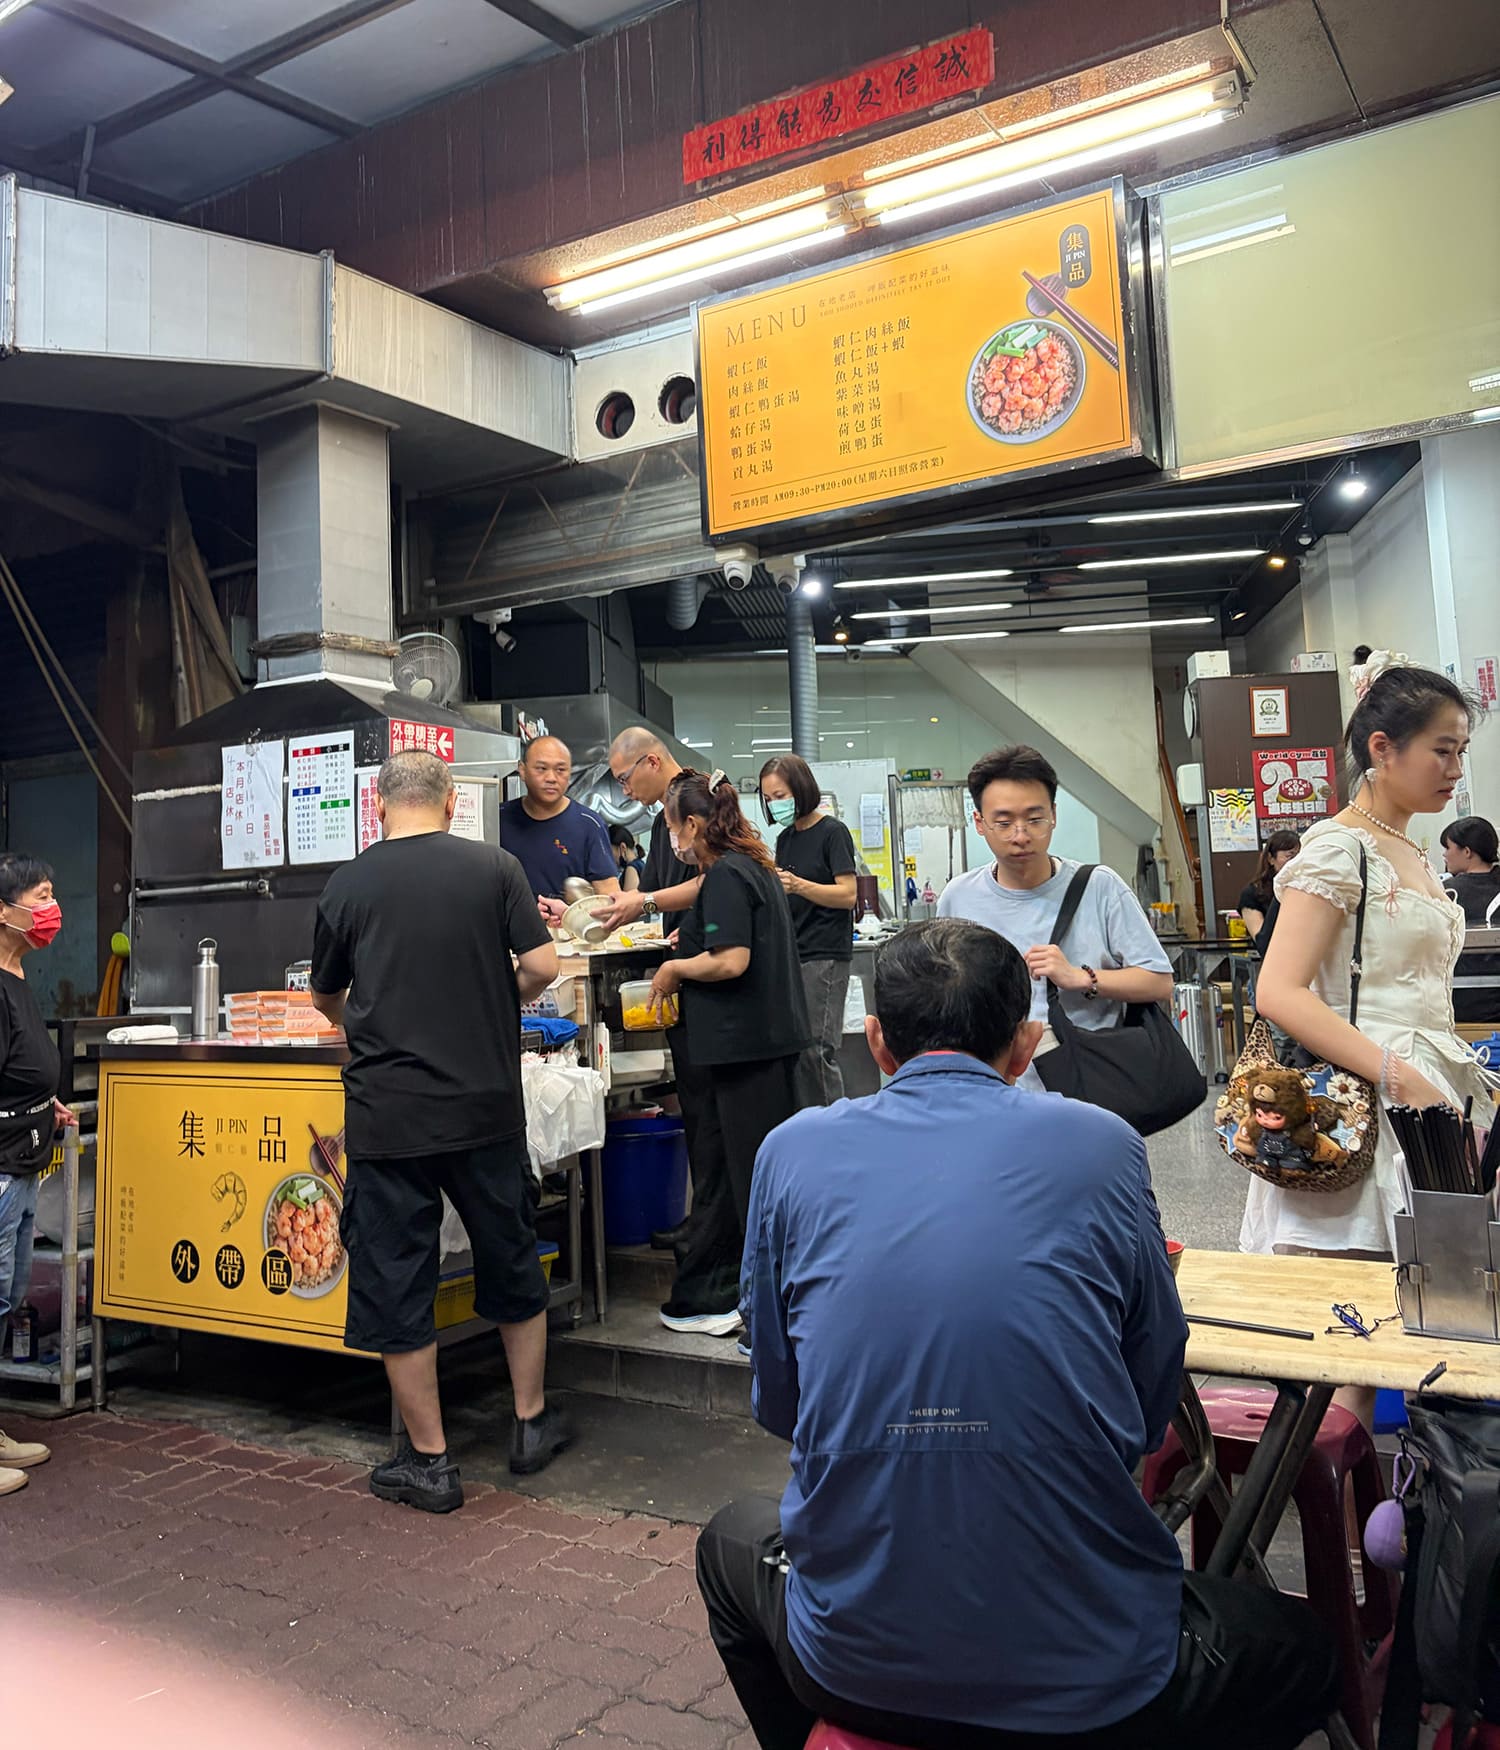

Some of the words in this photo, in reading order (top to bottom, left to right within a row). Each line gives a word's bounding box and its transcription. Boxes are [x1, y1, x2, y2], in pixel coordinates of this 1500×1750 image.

[1066, 231, 1084, 252] 集
[1069, 262, 1085, 282] 品
[726, 305, 807, 347] MENU
[833, 316, 911, 349] 蝦仁肉絲飯
[834, 336, 905, 367] 蝦仁飯+蝦
[727, 356, 768, 379] 蝦仁飯
[835, 361, 880, 385] 魚丸湯
[728, 377, 769, 399] 肉絲飯
[836, 379, 880, 402] 紫菜湯
[729, 390, 800, 419] 蝦仁鴨蛋湯
[836, 397, 881, 418] 味噌湯
[730, 419, 771, 439] 蛤仔湯
[838, 415, 882, 437] 荷包蛋
[731, 439, 772, 460] 鴨蛋湯
[839, 433, 883, 456] 煎鴨蛋
[732, 460, 773, 481] 貢丸湯
[733, 494, 769, 512] 營業時間
[1259, 751, 1289, 759] World
[177, 1110, 206, 1159] 集
[216, 1118, 224, 1135] JI
[229, 1119, 248, 1134] PIN
[258, 1116, 286, 1163] 品
[174, 1244, 290, 1290] 外帶區
